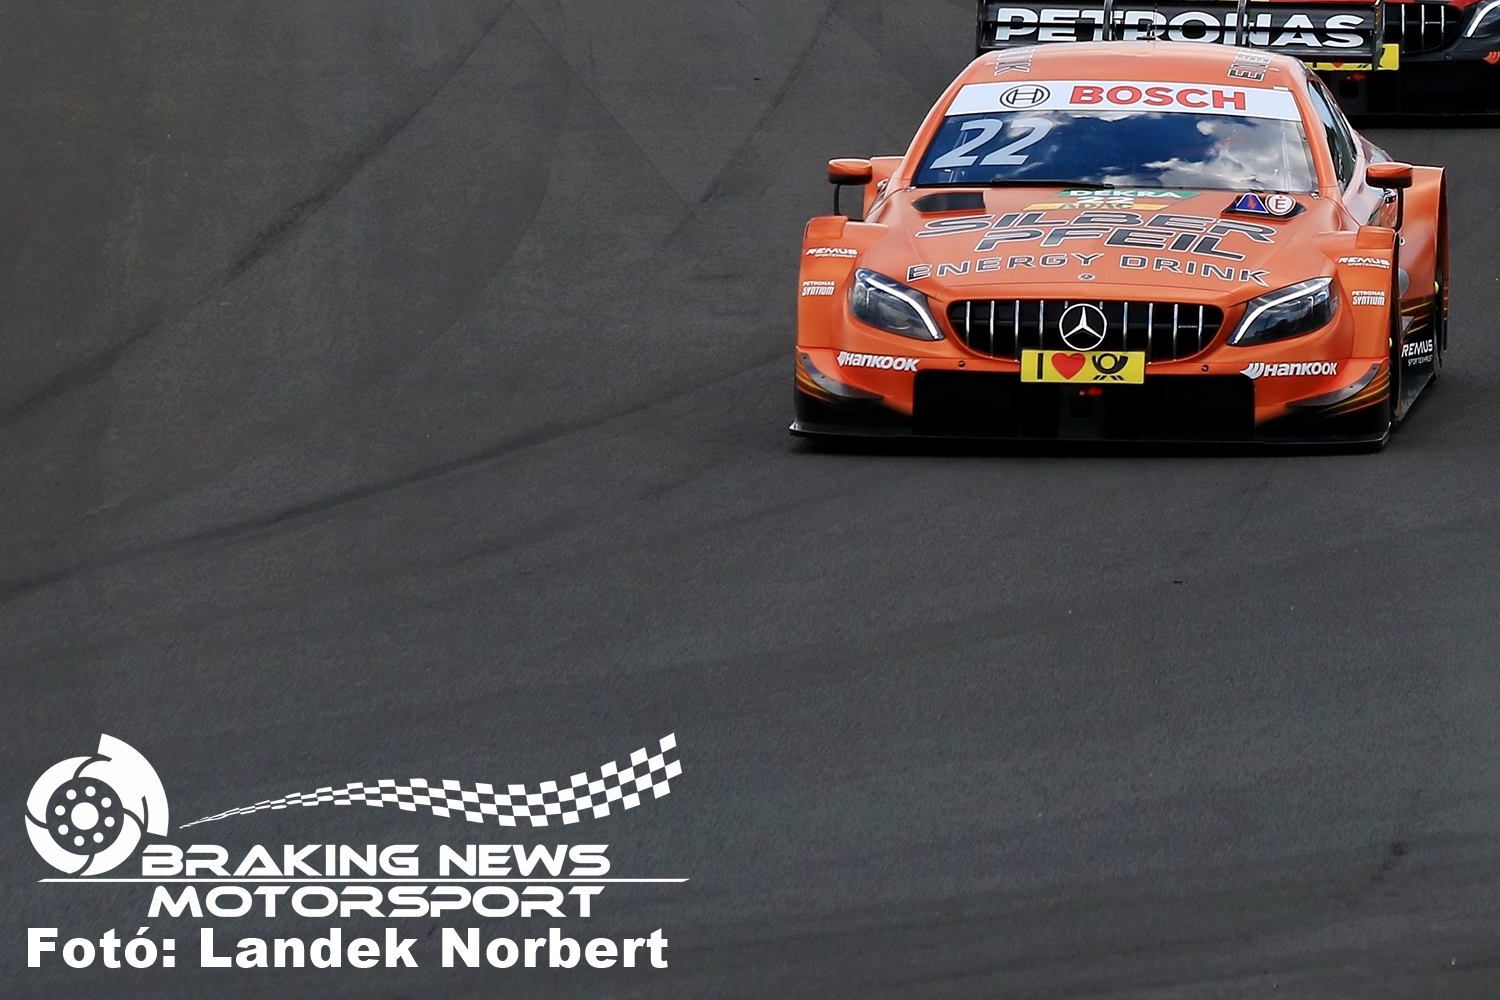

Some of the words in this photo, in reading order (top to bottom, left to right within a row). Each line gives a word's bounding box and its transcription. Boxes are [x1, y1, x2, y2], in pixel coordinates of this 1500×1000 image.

[995, 7, 1365, 48] PETRONAS
[1069, 85, 1247, 111] BOSCH
[929, 117, 1054, 170] 22
[1068, 189, 1183, 199] DEKRA
[1057, 203, 1134, 211] ADAC
[914, 210, 1278, 244] SILBER
[806, 247, 858, 256] REMUS
[973, 226, 1247, 261] PFEIL
[905, 252, 1105, 283] ENERGY
[1118, 254, 1272, 288] DRINK
[1338, 256, 1391, 267] REMUS
[801, 286, 835, 297] SYNTIUM
[1352, 296, 1386, 307] SYNTIUM
[1401, 339, 1434, 359] REMUS
